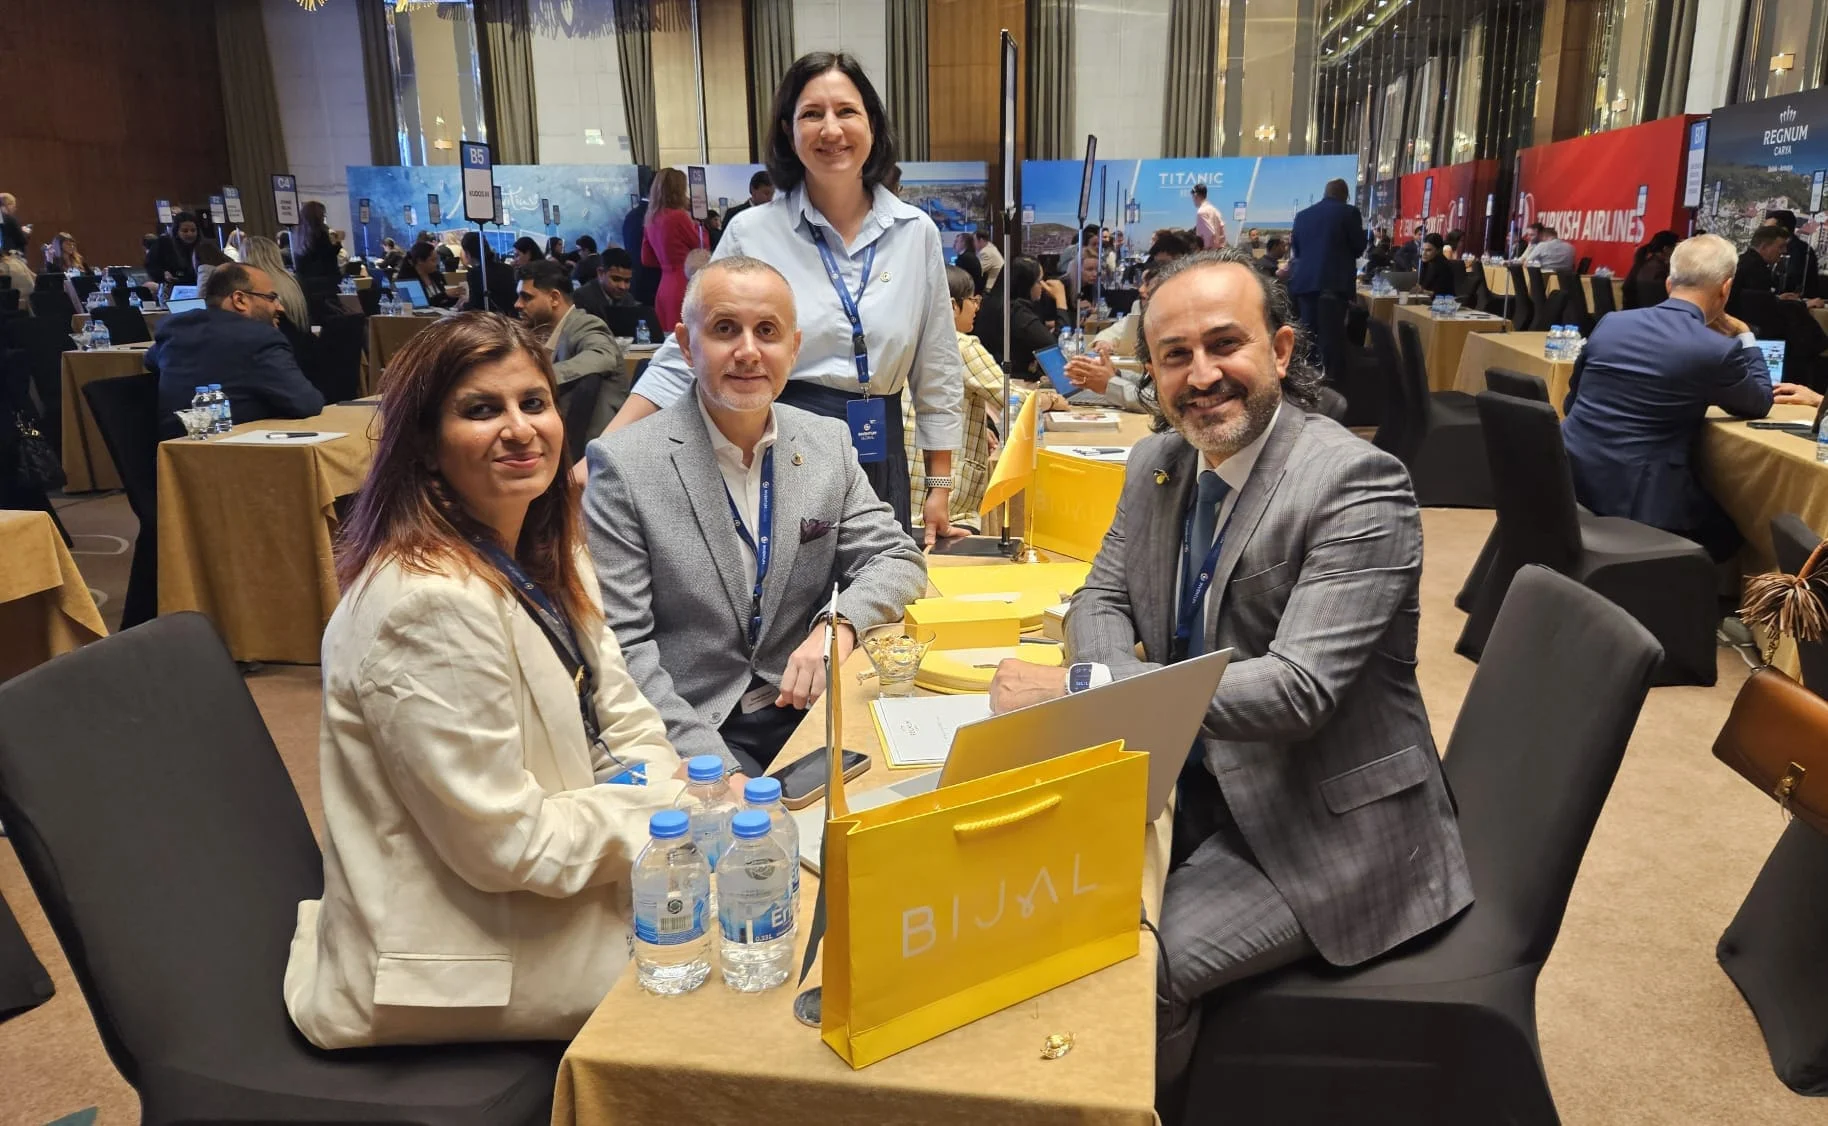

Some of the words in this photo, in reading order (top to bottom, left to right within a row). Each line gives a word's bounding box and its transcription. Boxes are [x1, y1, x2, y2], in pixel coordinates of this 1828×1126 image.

[1763, 124, 1809, 145] REGNUM
[469, 147, 485, 165] B5
[1773, 145, 1792, 157] CARYA
[277, 177, 291, 189] C4
[1158, 172, 1224, 185] TITANIC
[902, 853, 1099, 959] BIJAL
